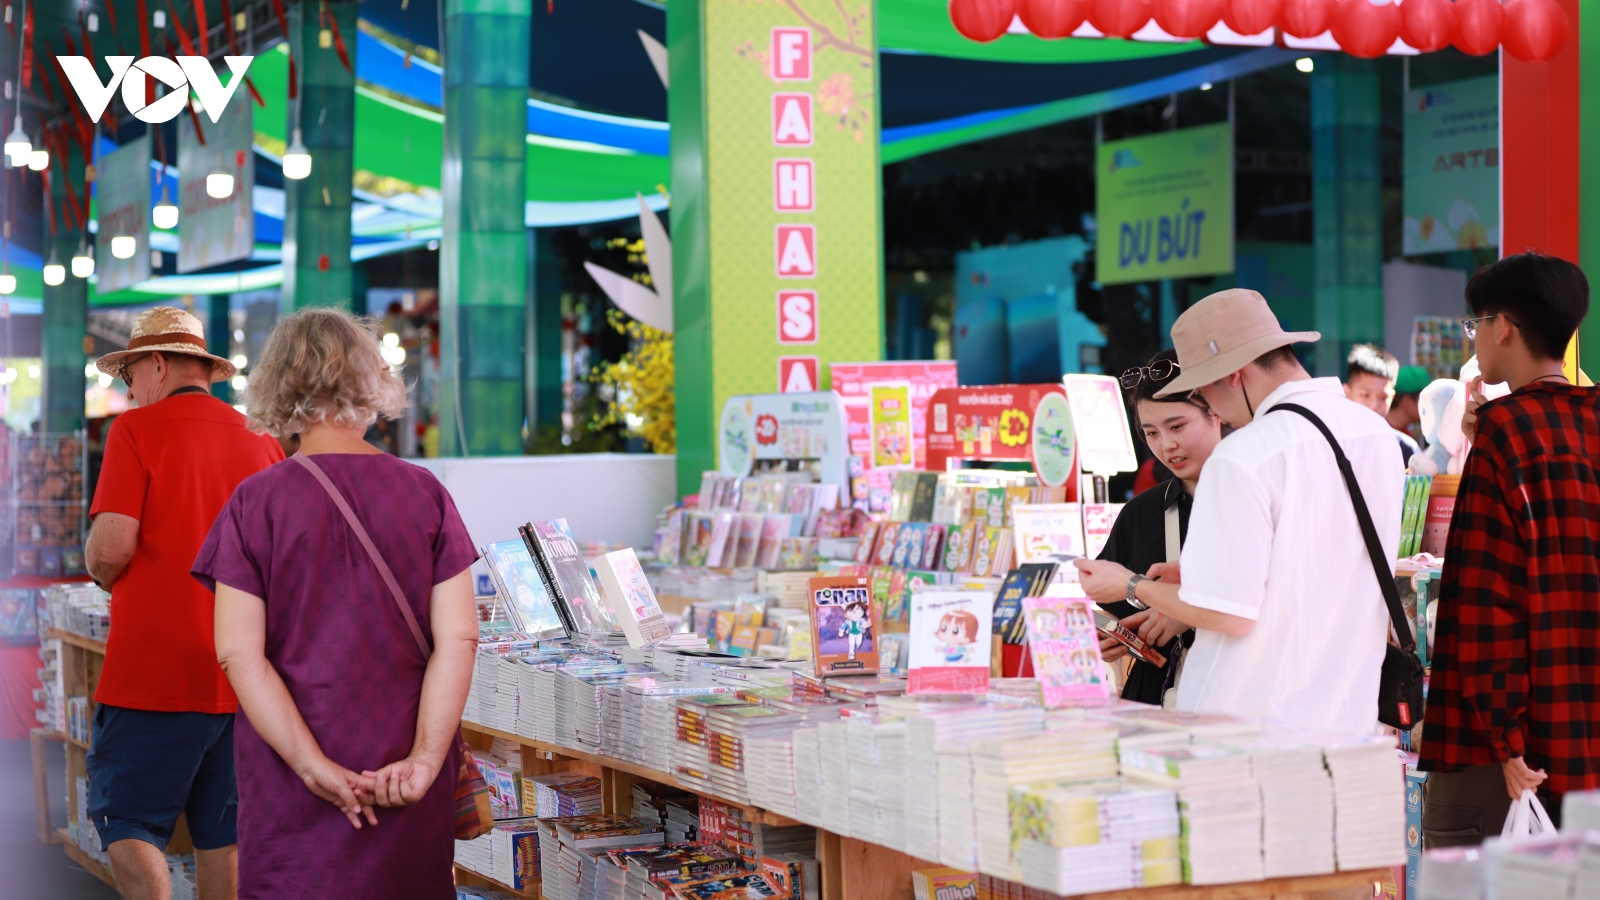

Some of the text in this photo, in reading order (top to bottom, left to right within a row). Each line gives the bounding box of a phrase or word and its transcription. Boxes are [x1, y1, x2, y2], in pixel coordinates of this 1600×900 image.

[775, 32, 815, 393] FAHASA
[1118, 196, 1206, 269] DU BÚT
[541, 537, 579, 559] TOTORO
[1408, 793, 1418, 805] 40
